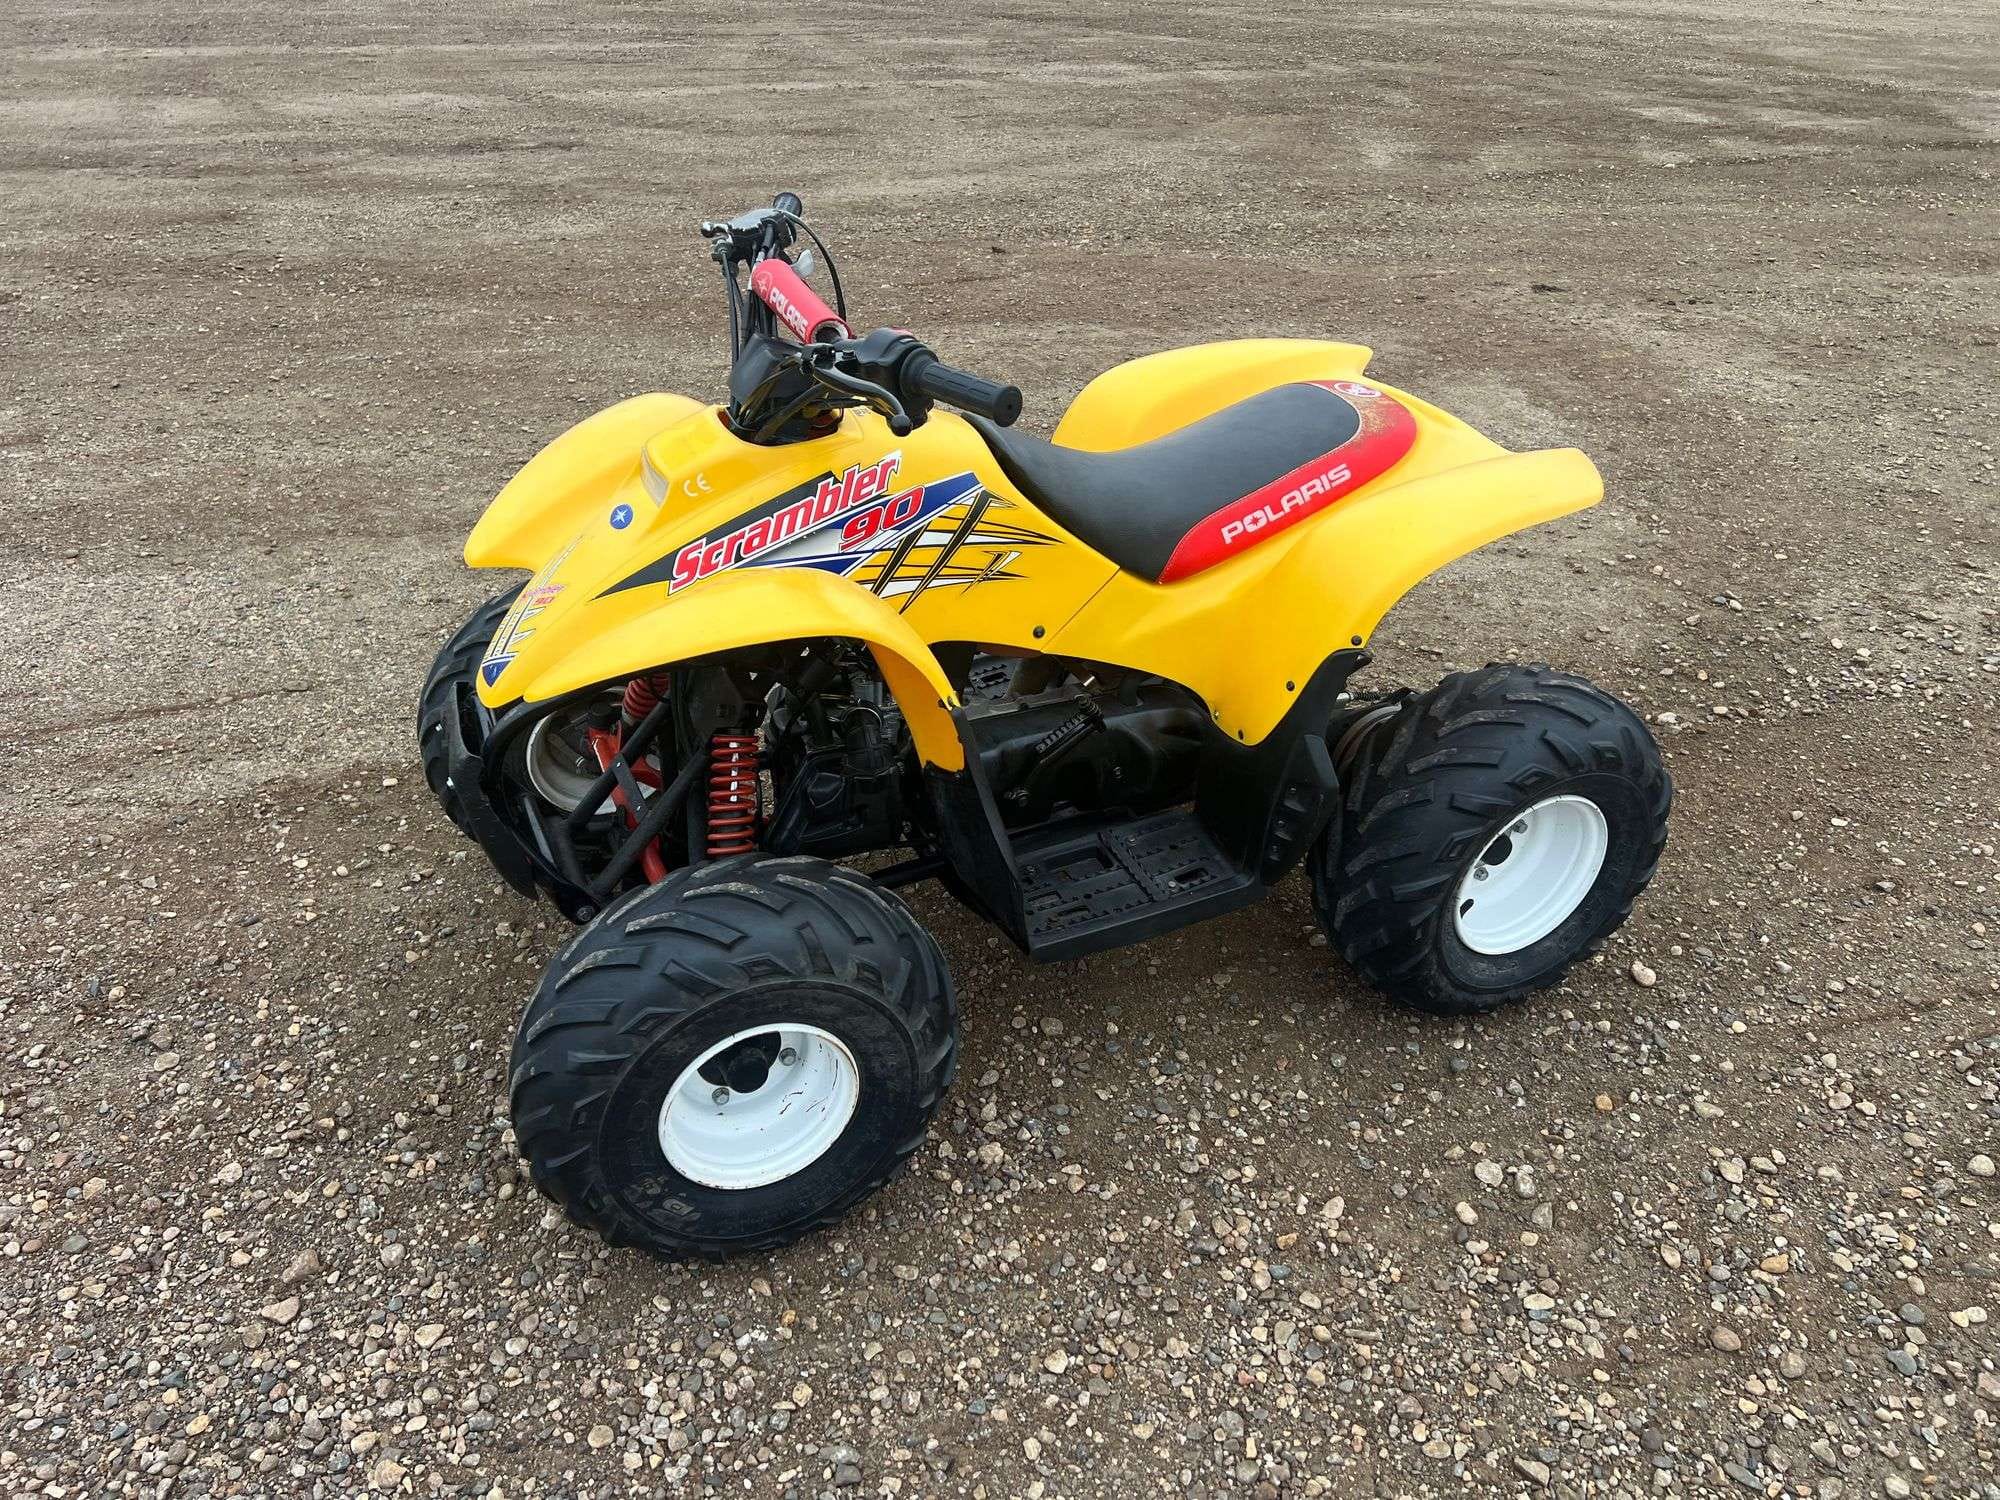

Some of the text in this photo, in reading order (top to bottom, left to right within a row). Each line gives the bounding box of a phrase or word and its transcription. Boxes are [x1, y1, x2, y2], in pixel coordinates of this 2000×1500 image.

[769, 286, 809, 339] POLARIS
[682, 472, 714, 498] CE
[839, 485, 927, 554] 90
[1221, 463, 1352, 545] POLARIS
[668, 453, 901, 595] Scrambler
